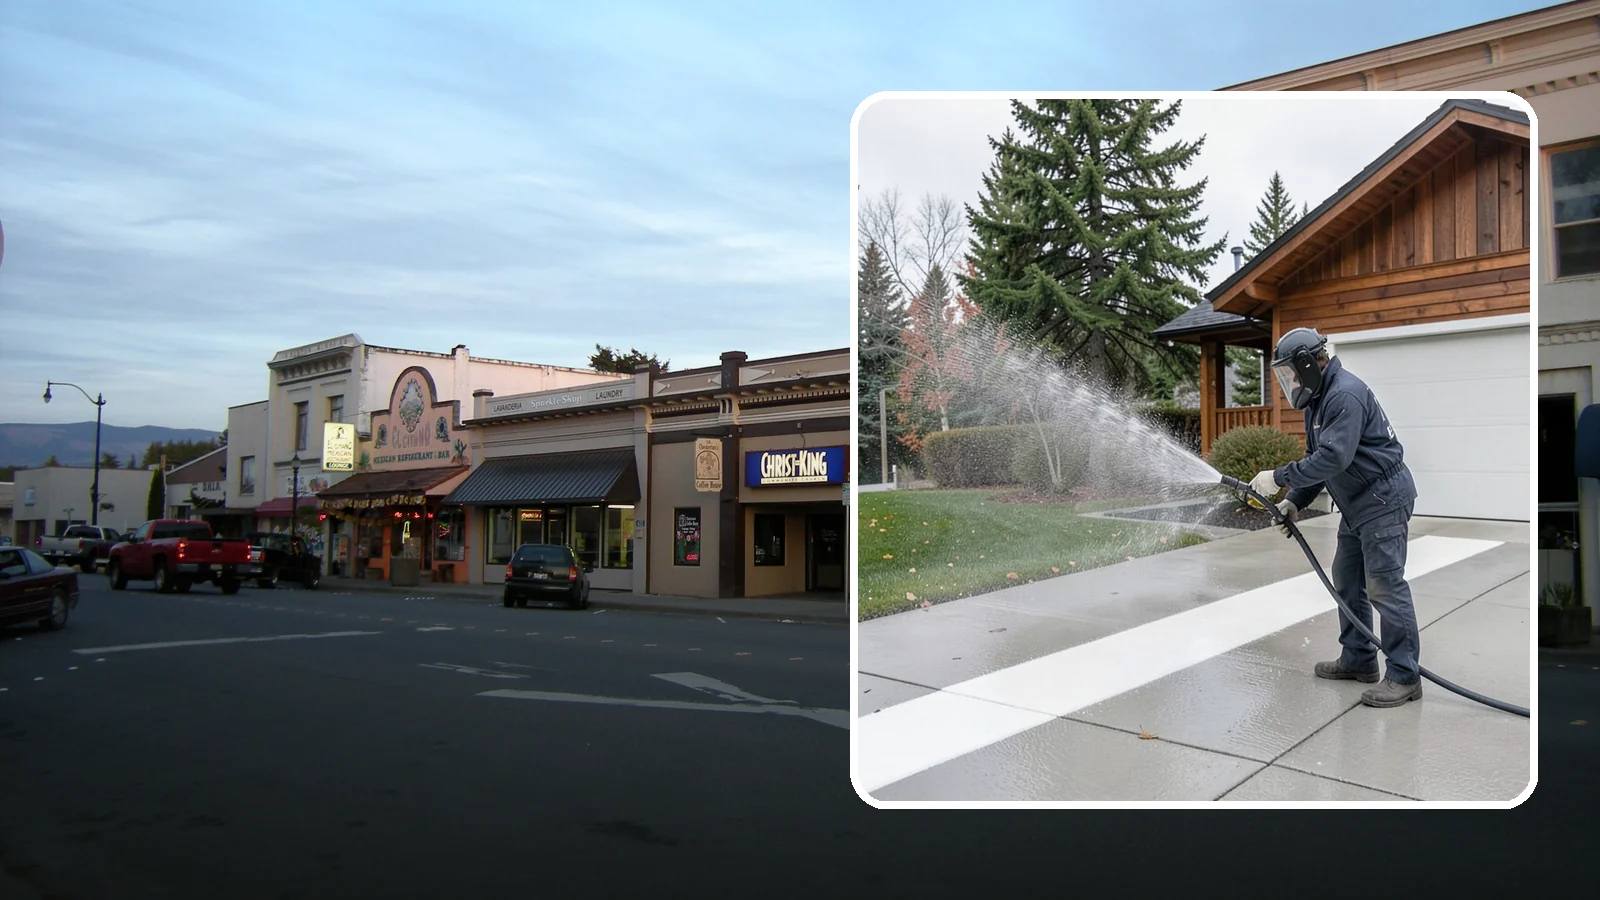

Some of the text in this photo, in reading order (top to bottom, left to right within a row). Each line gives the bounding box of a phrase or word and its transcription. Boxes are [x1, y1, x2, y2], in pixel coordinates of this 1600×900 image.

[562, 394, 582, 405] Shop
[595, 389, 624, 400] LAUNDRY
[494, 402, 523, 413] LAVANDERIA
[374, 455, 396, 464] MEXICAN
[397, 452, 434, 462] RESTAURANT
[438, 450, 450, 459] BAR
[761, 450, 827, 478] CHRIST KING
[697, 481, 709, 489] Coffee
